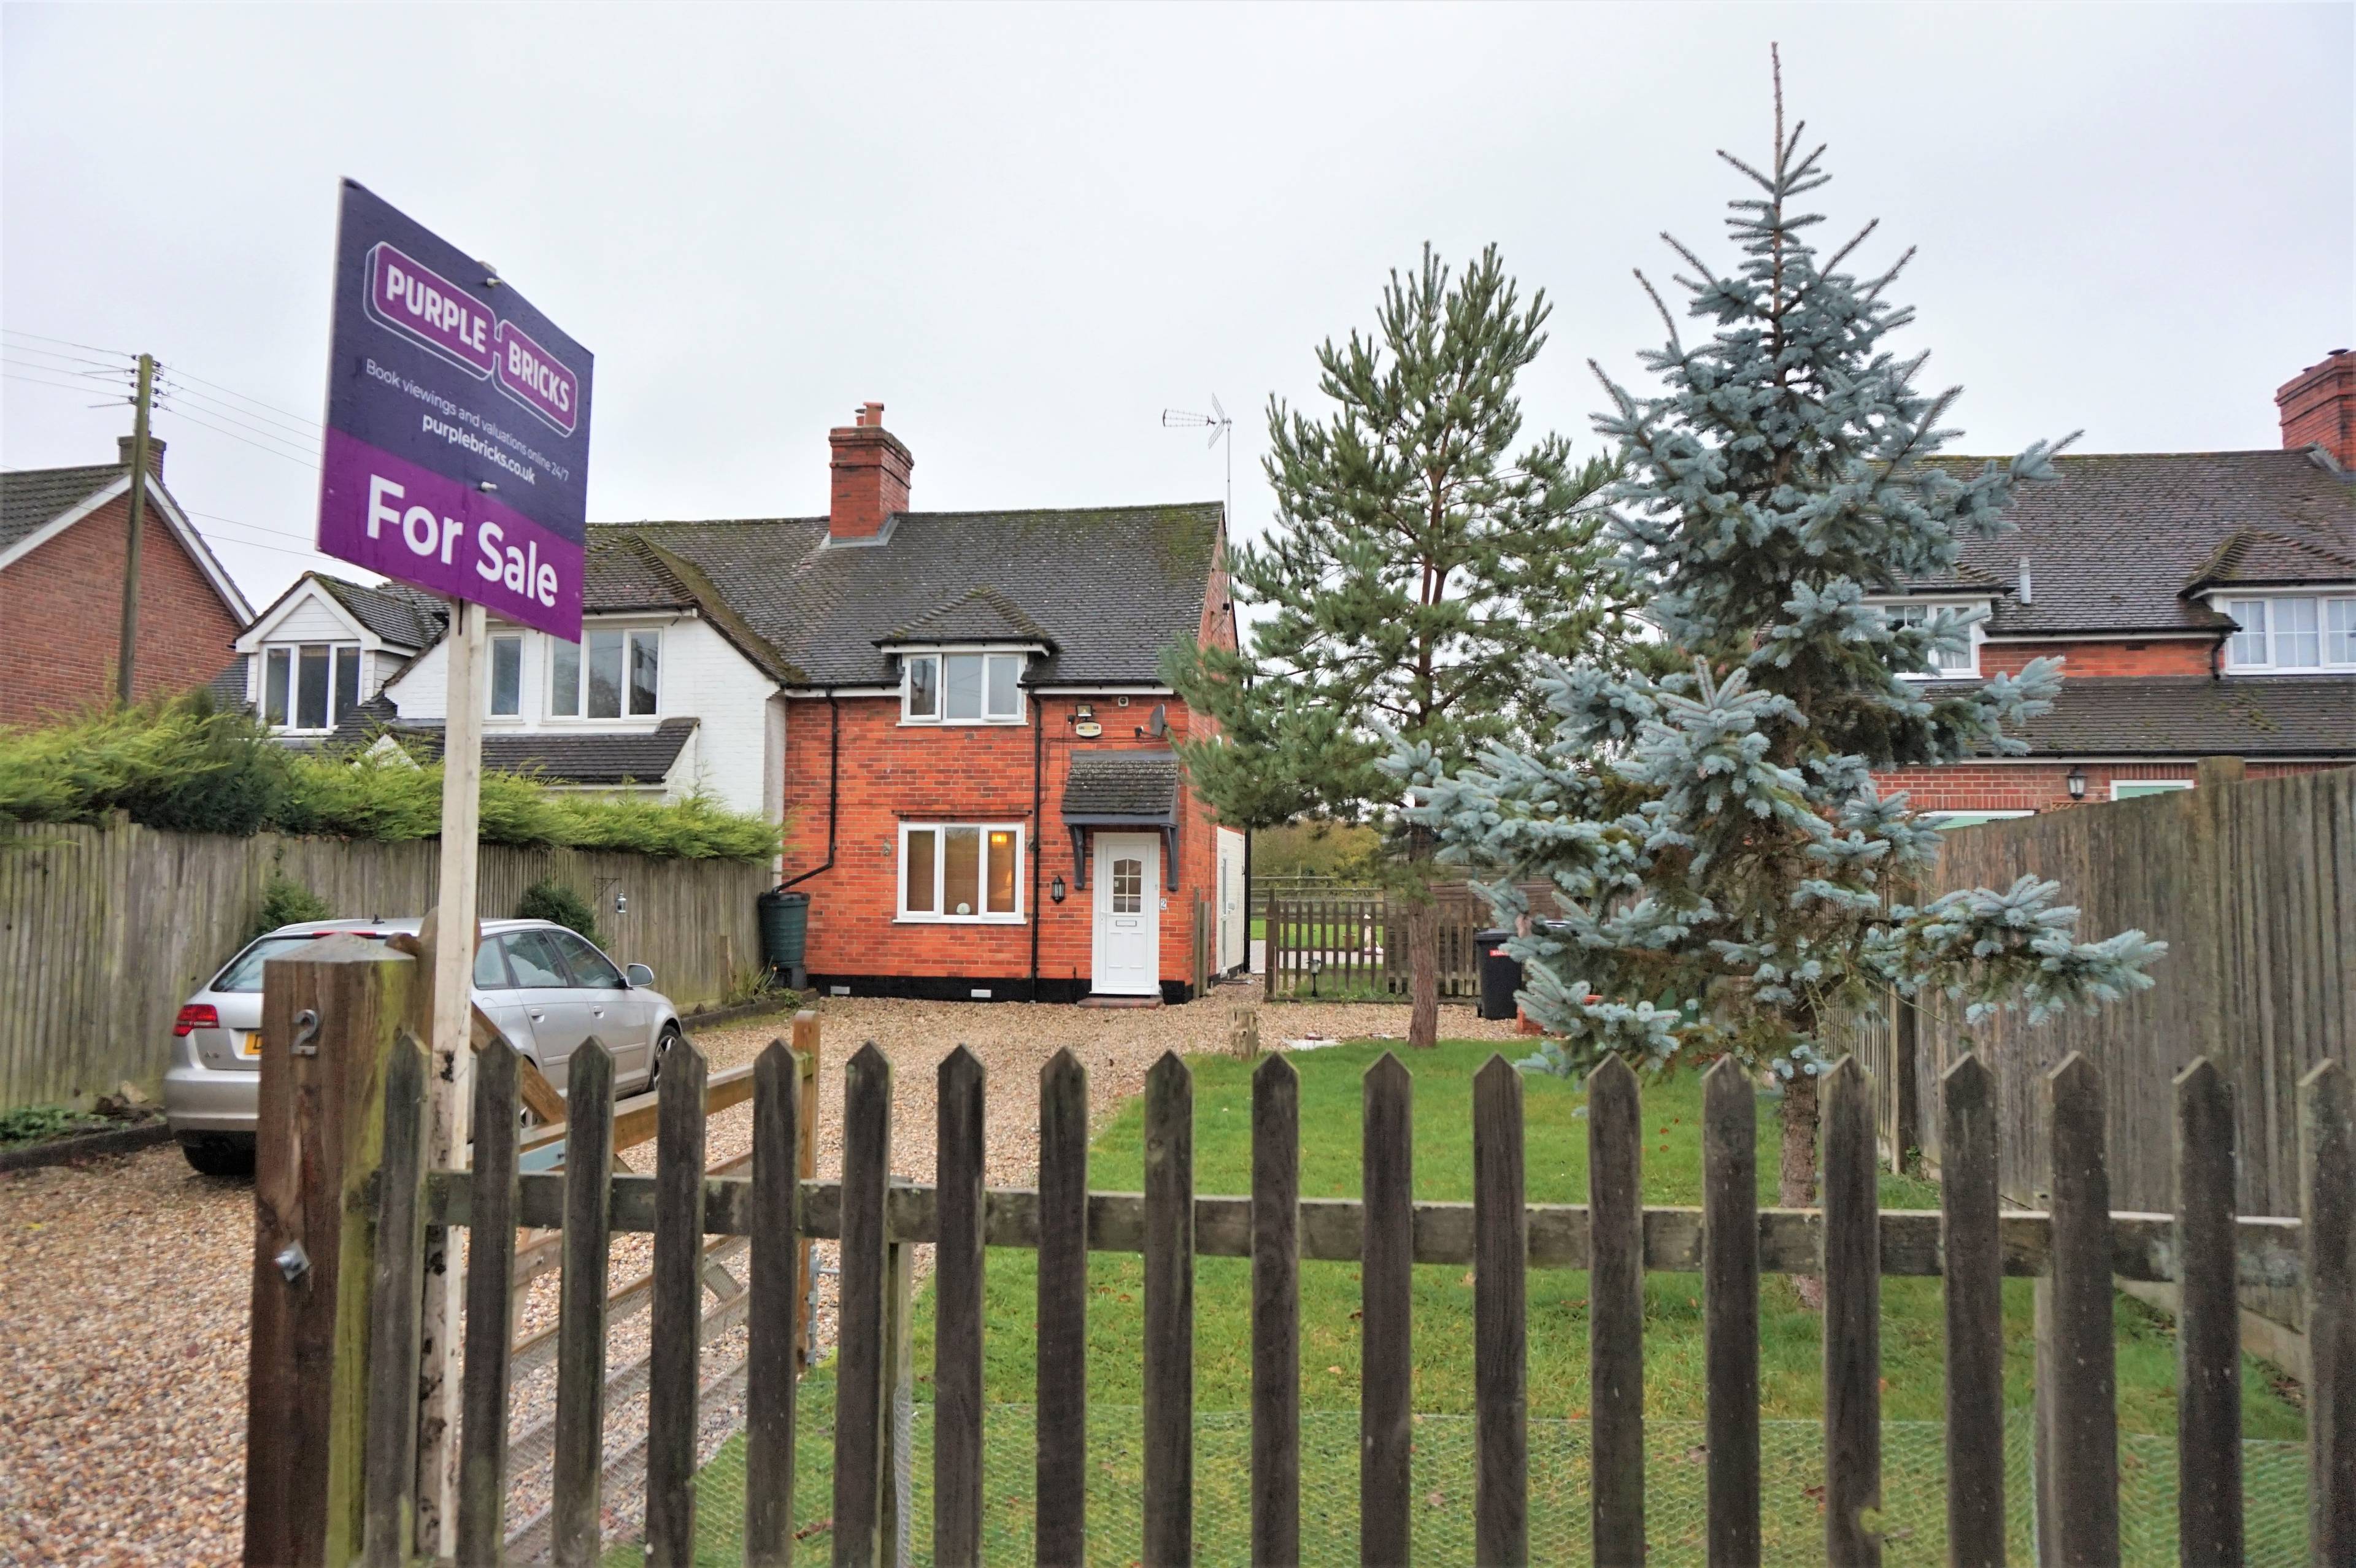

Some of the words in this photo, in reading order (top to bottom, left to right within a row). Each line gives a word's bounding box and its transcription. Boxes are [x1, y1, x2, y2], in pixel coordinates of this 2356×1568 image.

[387, 264, 487, 354] PURPLE
[508, 340, 570, 412] BRICKS
[366, 358, 401, 388] Book
[402, 379, 457, 416] viewings
[458, 408, 480, 428] and
[482, 420, 527, 456] valuations
[527, 448, 552, 471] online
[551, 462, 569, 481] 24/7
[422, 414, 536, 485] purplebricks.co.uk
[367, 474, 463, 565] For
[476, 521, 558, 607] Sale
[1161, 899, 1166, 909] 2
[290, 1009, 319, 1055] 2
